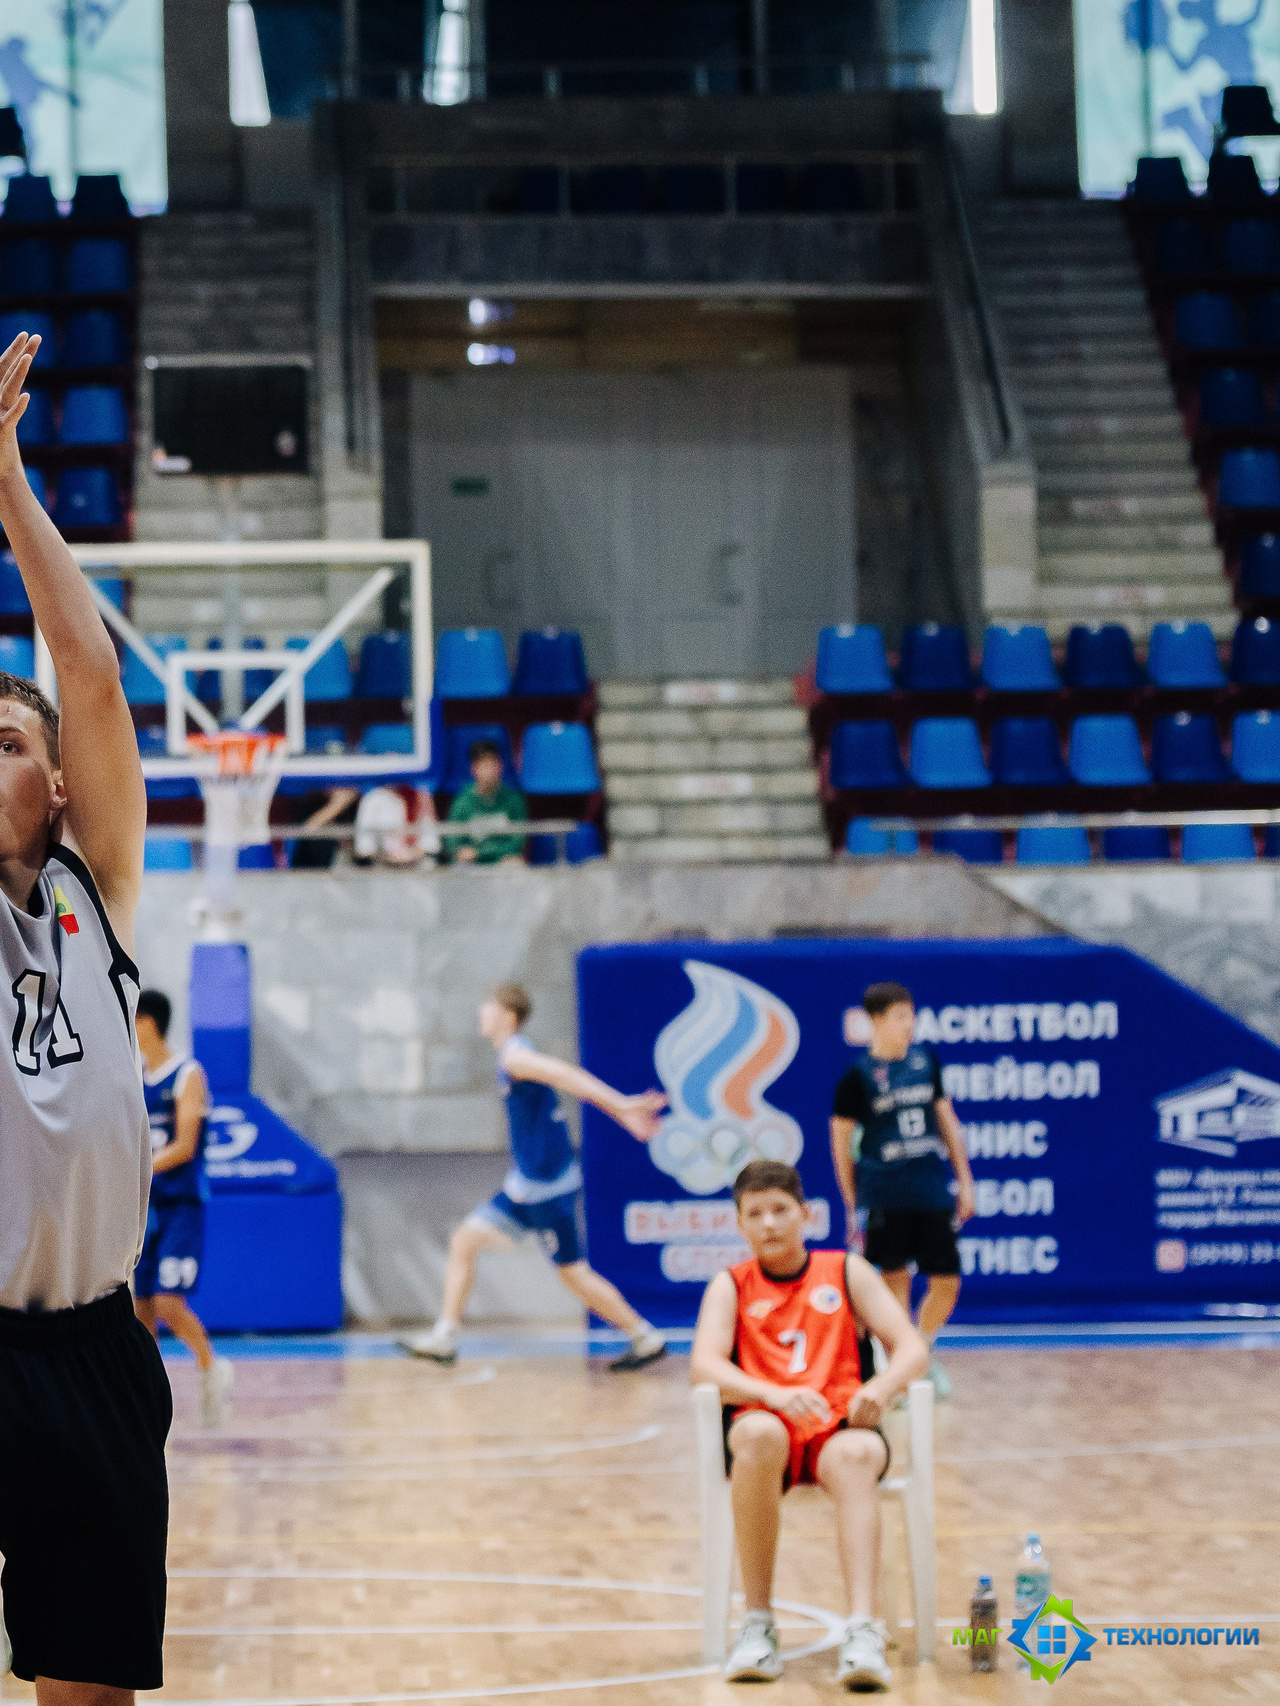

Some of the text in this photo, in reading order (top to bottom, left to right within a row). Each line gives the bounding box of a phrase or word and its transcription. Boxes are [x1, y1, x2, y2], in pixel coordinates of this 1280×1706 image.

[11, 968, 85, 1077] 11
[913, 1001, 1119, 1044] АСКЕТБОЛ
[941, 1056, 1101, 1101] ЛЕЙБОЛ
[956, 1235, 1061, 1277] ТНЕС
[778, 1329, 808, 1374] 7
